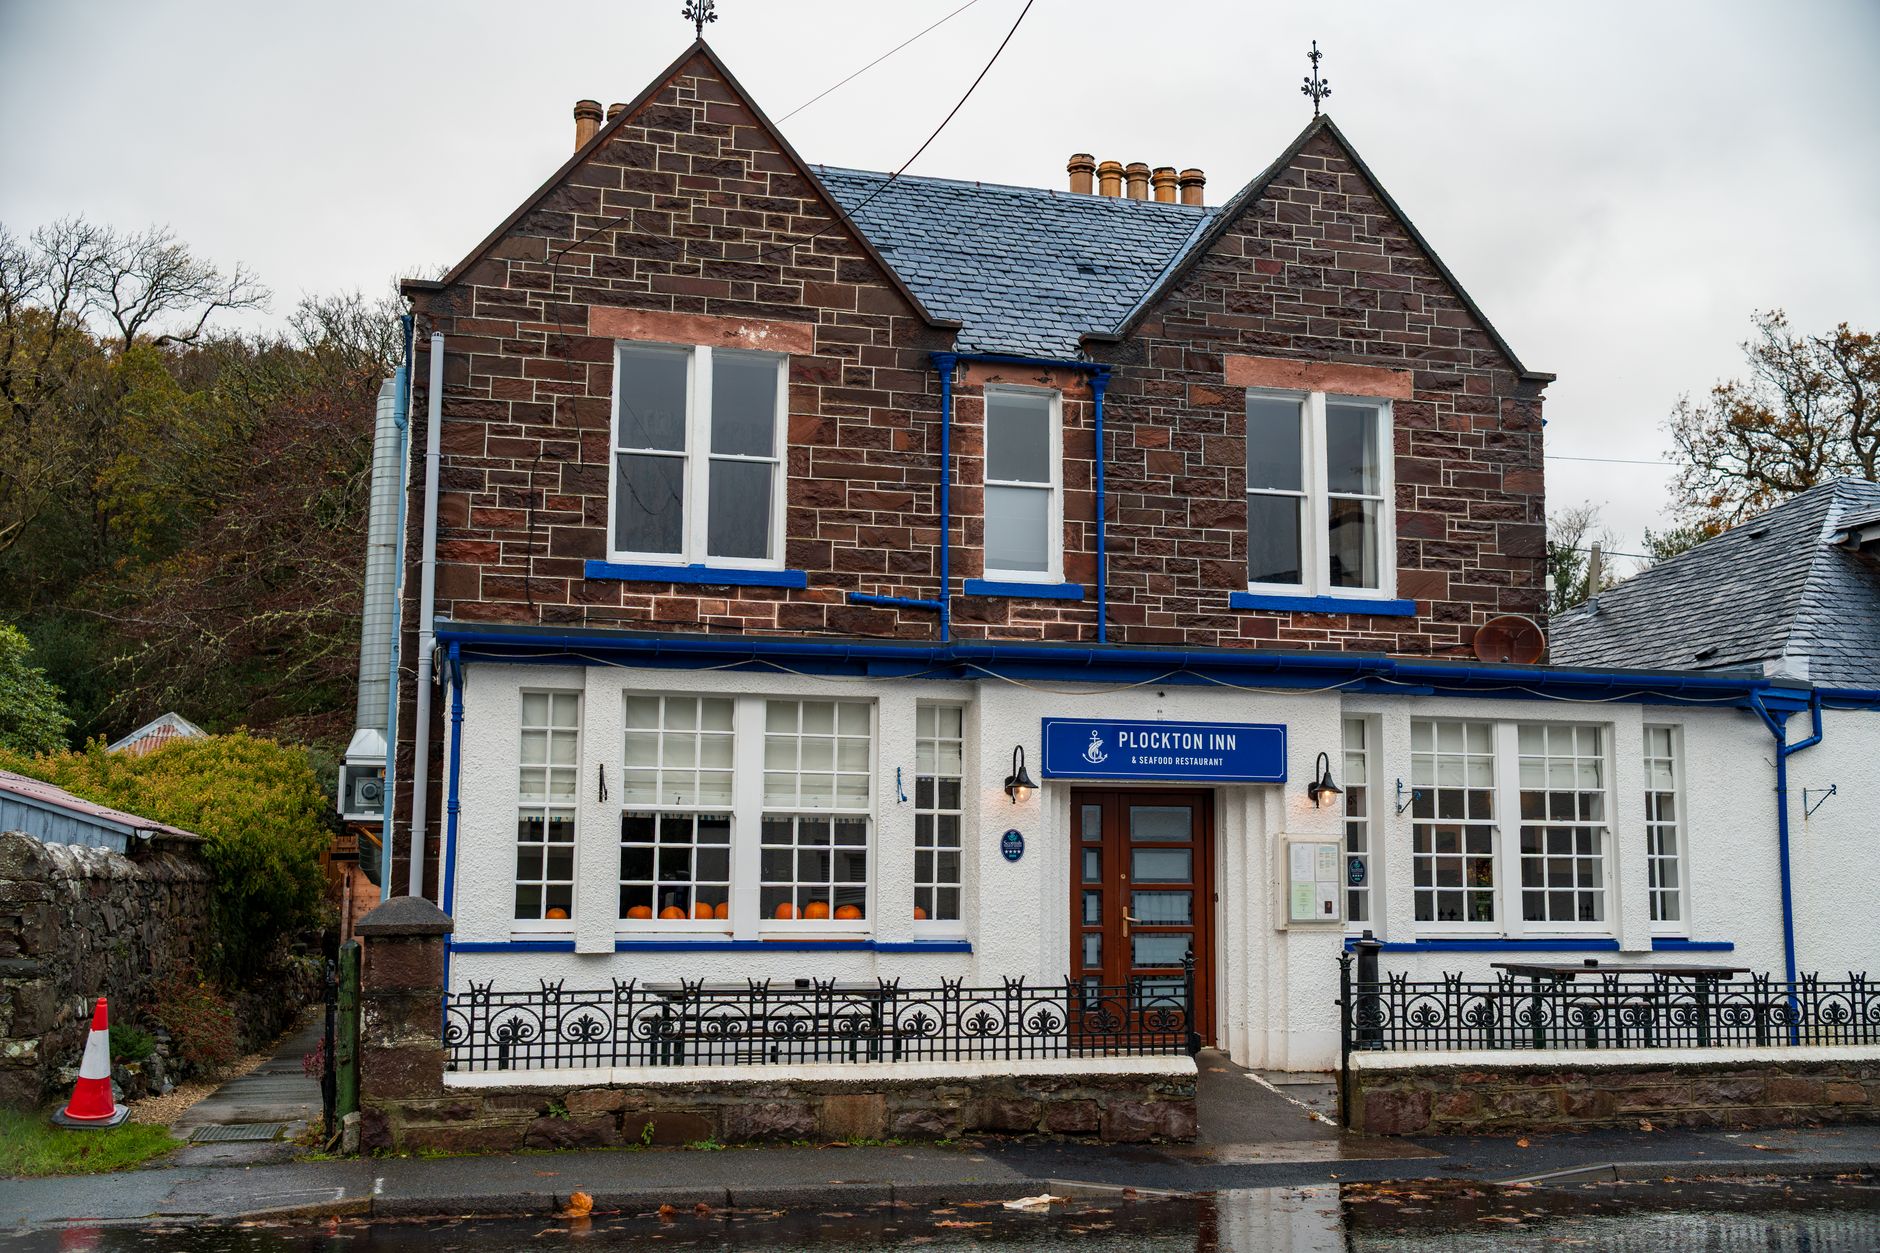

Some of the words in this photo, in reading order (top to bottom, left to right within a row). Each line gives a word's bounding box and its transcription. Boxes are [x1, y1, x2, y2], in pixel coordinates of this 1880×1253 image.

[1119, 731, 1203, 750] PLOCKTON
[1210, 733, 1236, 751] INN
[1132, 756, 1137, 764] &
[1139, 756, 1173, 765] SEAFOOD
[1175, 757, 1223, 766] RESTAURANT
